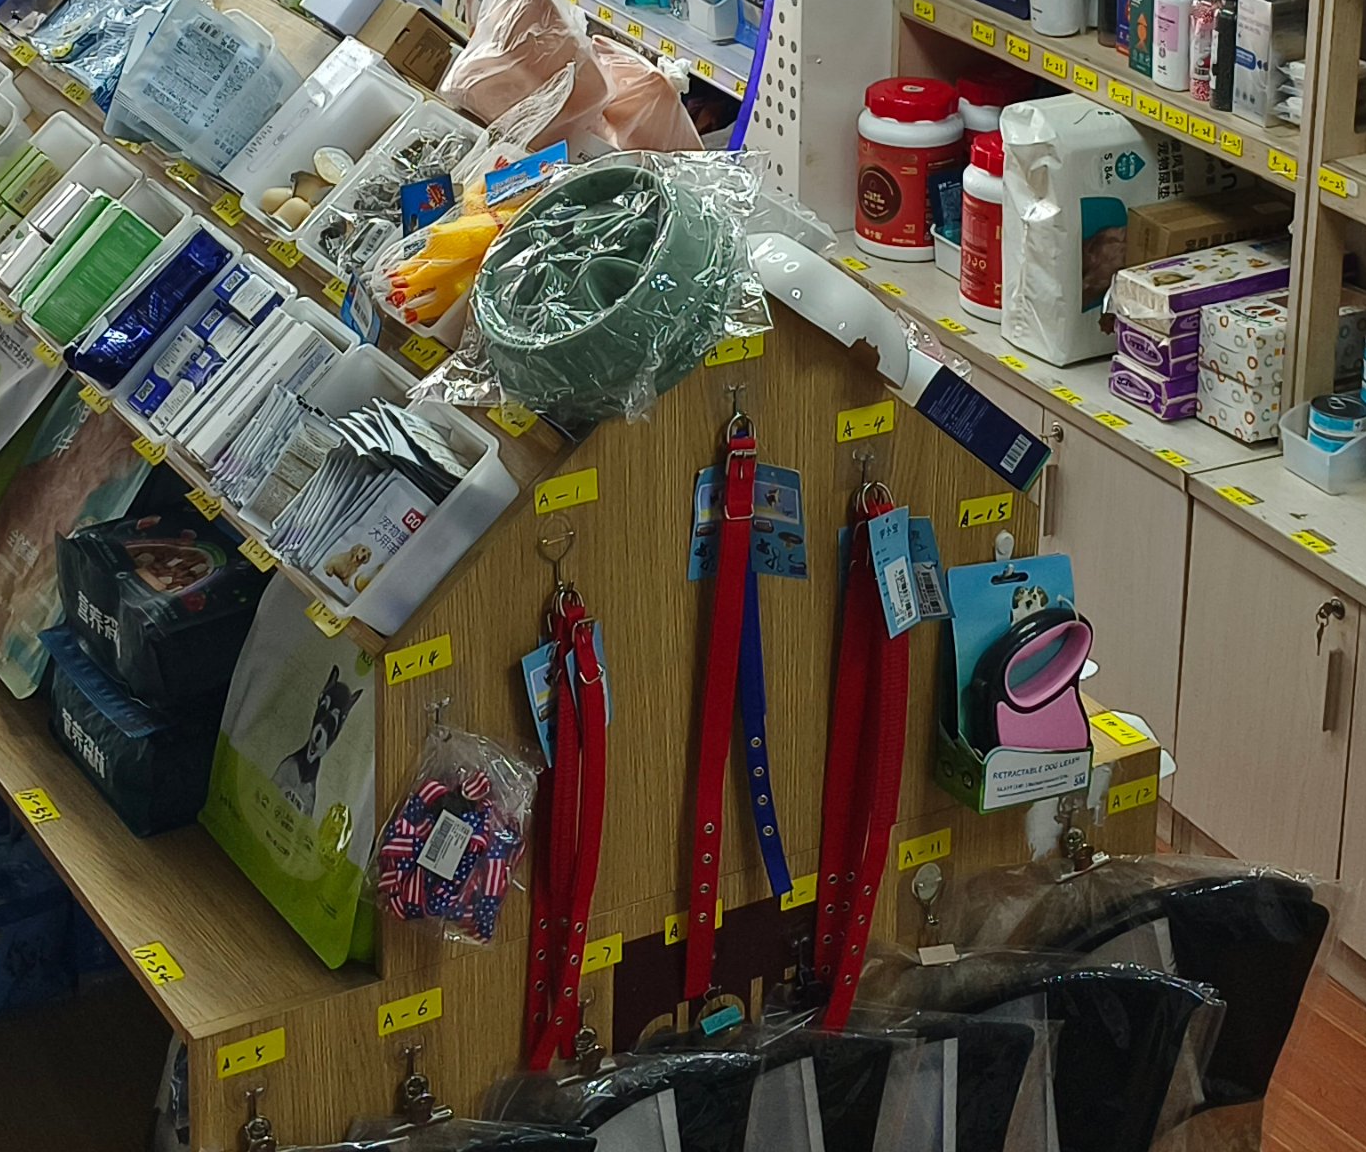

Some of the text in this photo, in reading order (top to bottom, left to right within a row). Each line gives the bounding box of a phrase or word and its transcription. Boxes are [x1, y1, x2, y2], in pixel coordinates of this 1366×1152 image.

[841, 415, 885, 438] A-4
[538, 486, 581, 508] A-1
[405, 512, 422, 529] GO
[960, 504, 1009, 525] A-15
[391, 650, 441, 680] A-14
[1112, 787, 1153, 808] A-12
[903, 841, 941, 864] A-11
[586, 946, 613, 964] -7
[382, 1001, 428, 1028] A-6
